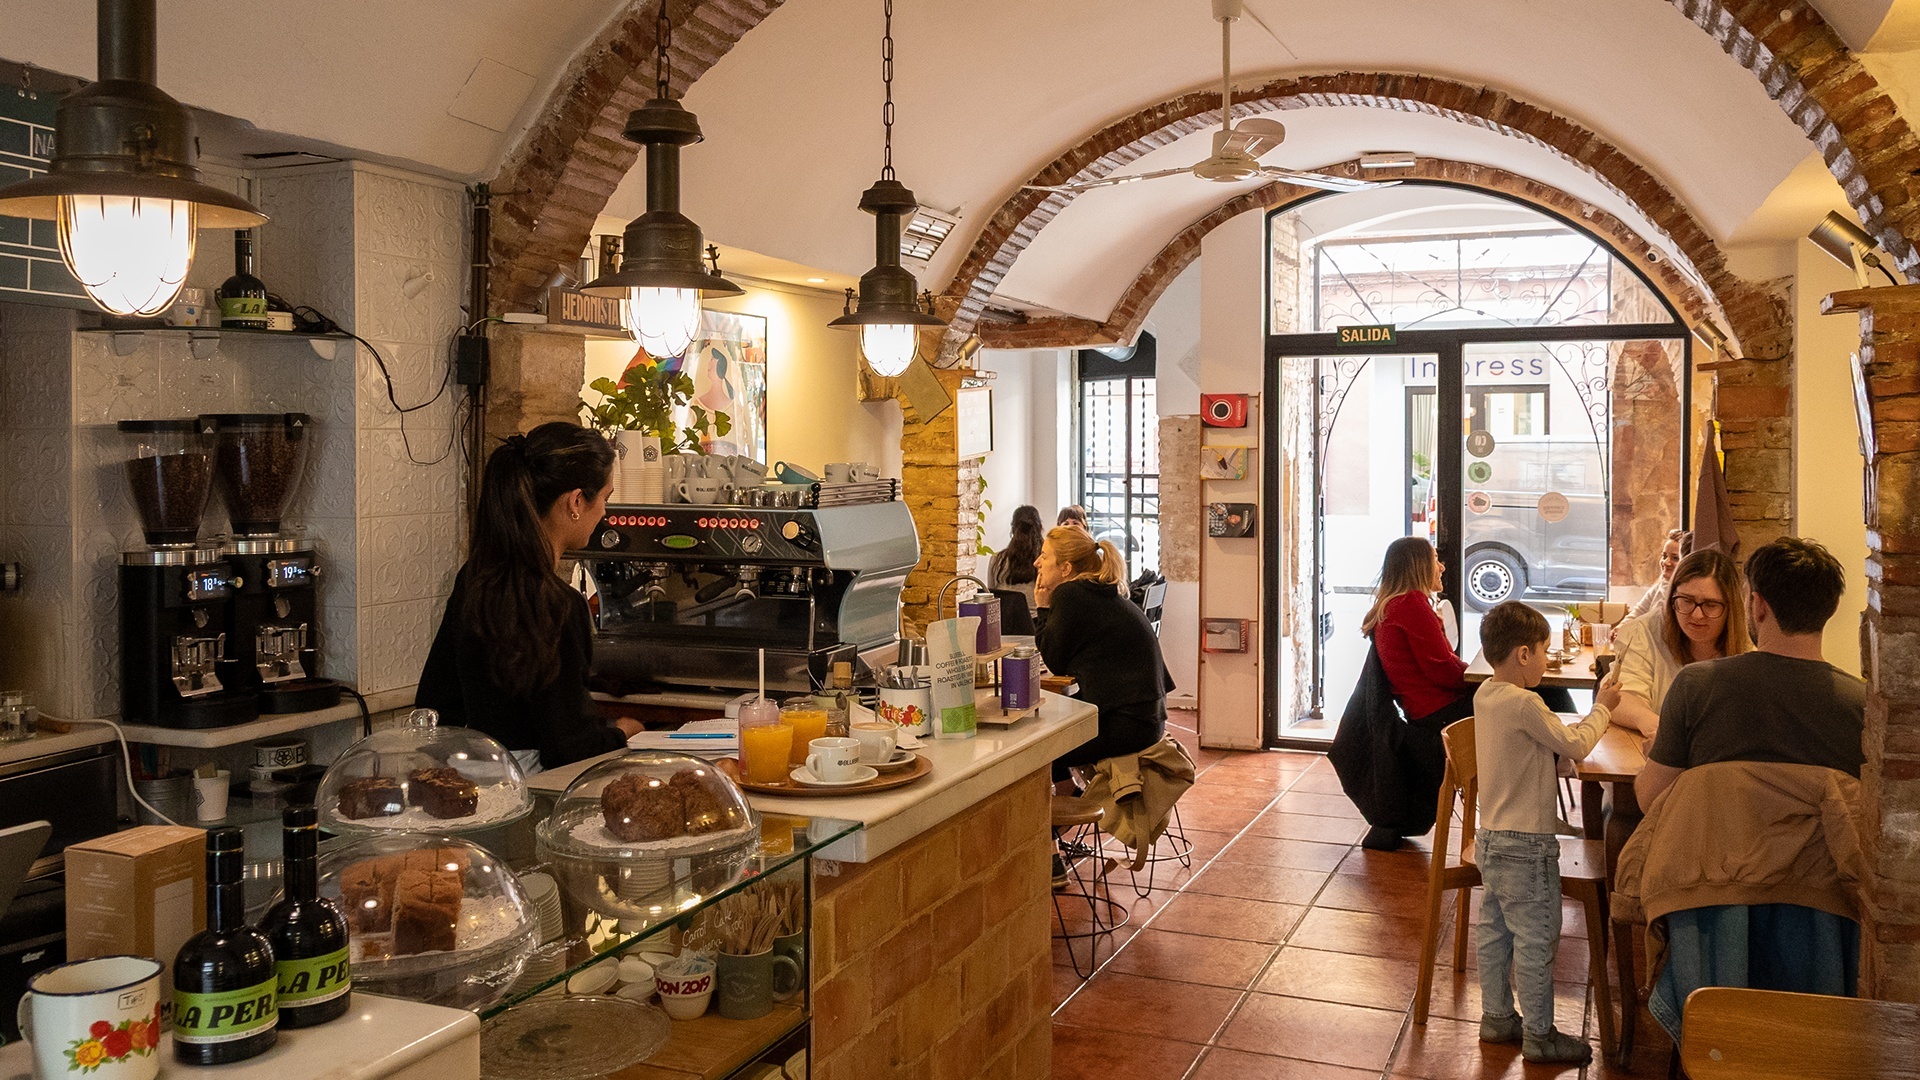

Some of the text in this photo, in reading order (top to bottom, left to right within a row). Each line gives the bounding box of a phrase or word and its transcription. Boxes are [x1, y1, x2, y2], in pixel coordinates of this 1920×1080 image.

[562, 292, 619, 326] HEDONISTA
[1341, 328, 1391, 342] SALIDA
[935, 660, 955, 669] COFFEE
[681, 975, 711, 995] 2019
